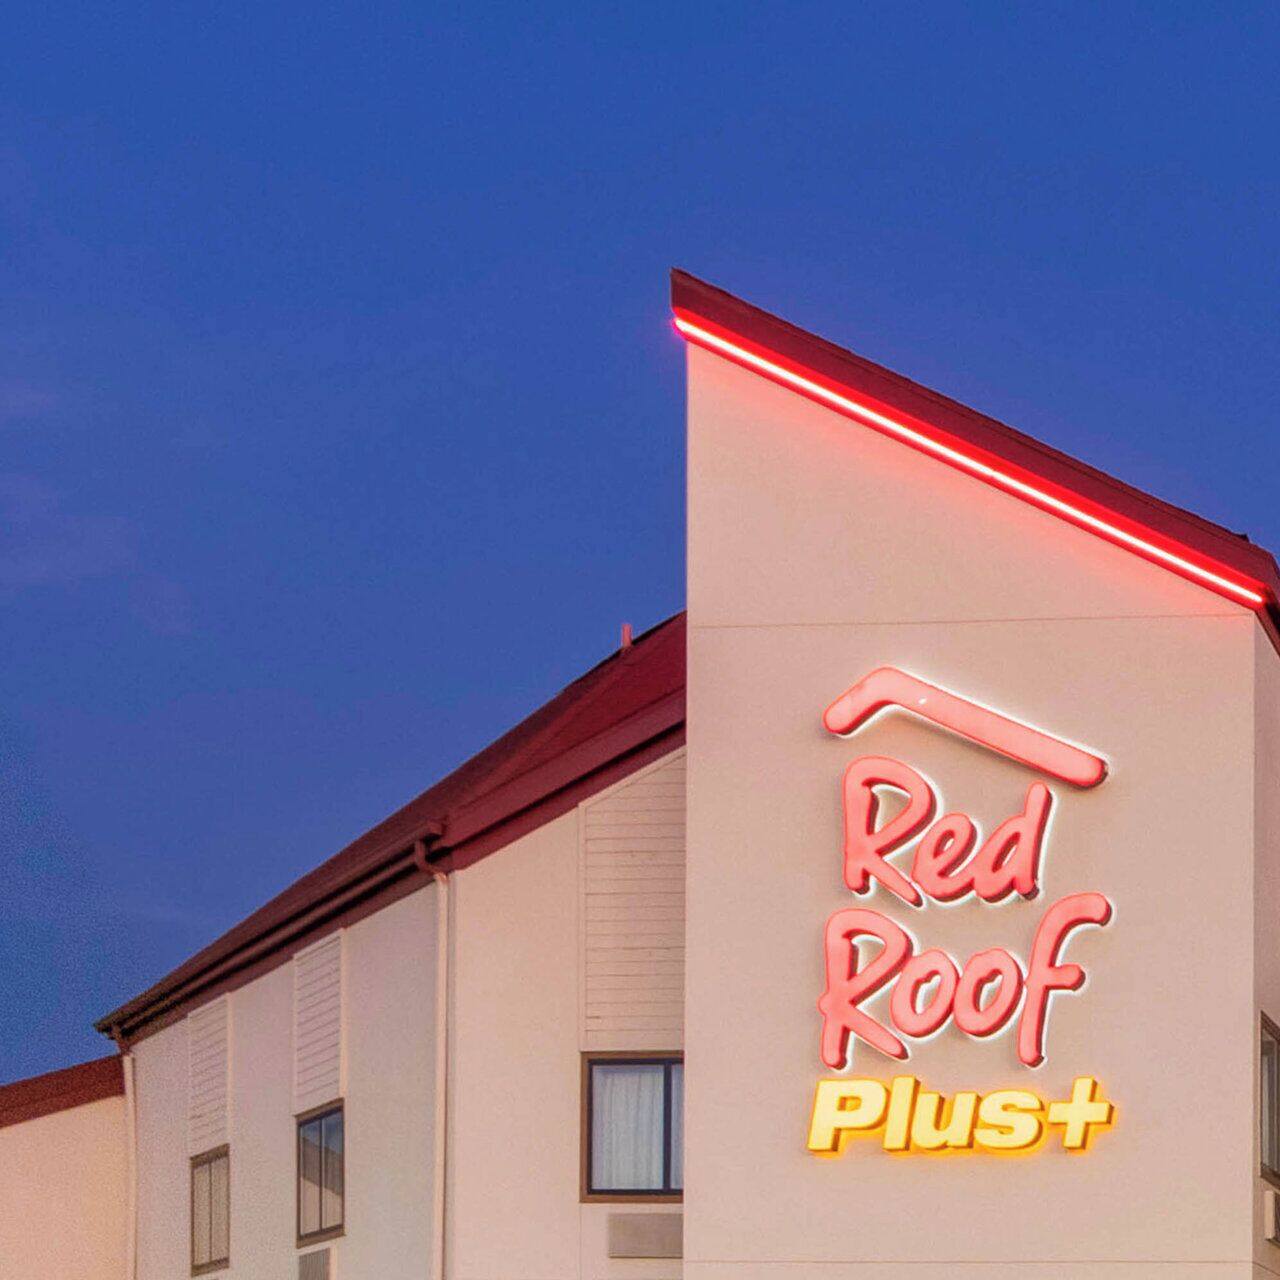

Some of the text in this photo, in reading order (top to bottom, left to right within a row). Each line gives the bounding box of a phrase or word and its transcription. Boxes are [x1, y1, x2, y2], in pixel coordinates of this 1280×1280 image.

[842, 755, 1054, 907] Red
[817, 892, 1112, 1070] Roof
[807, 1075, 1115, 1152] Plus+
